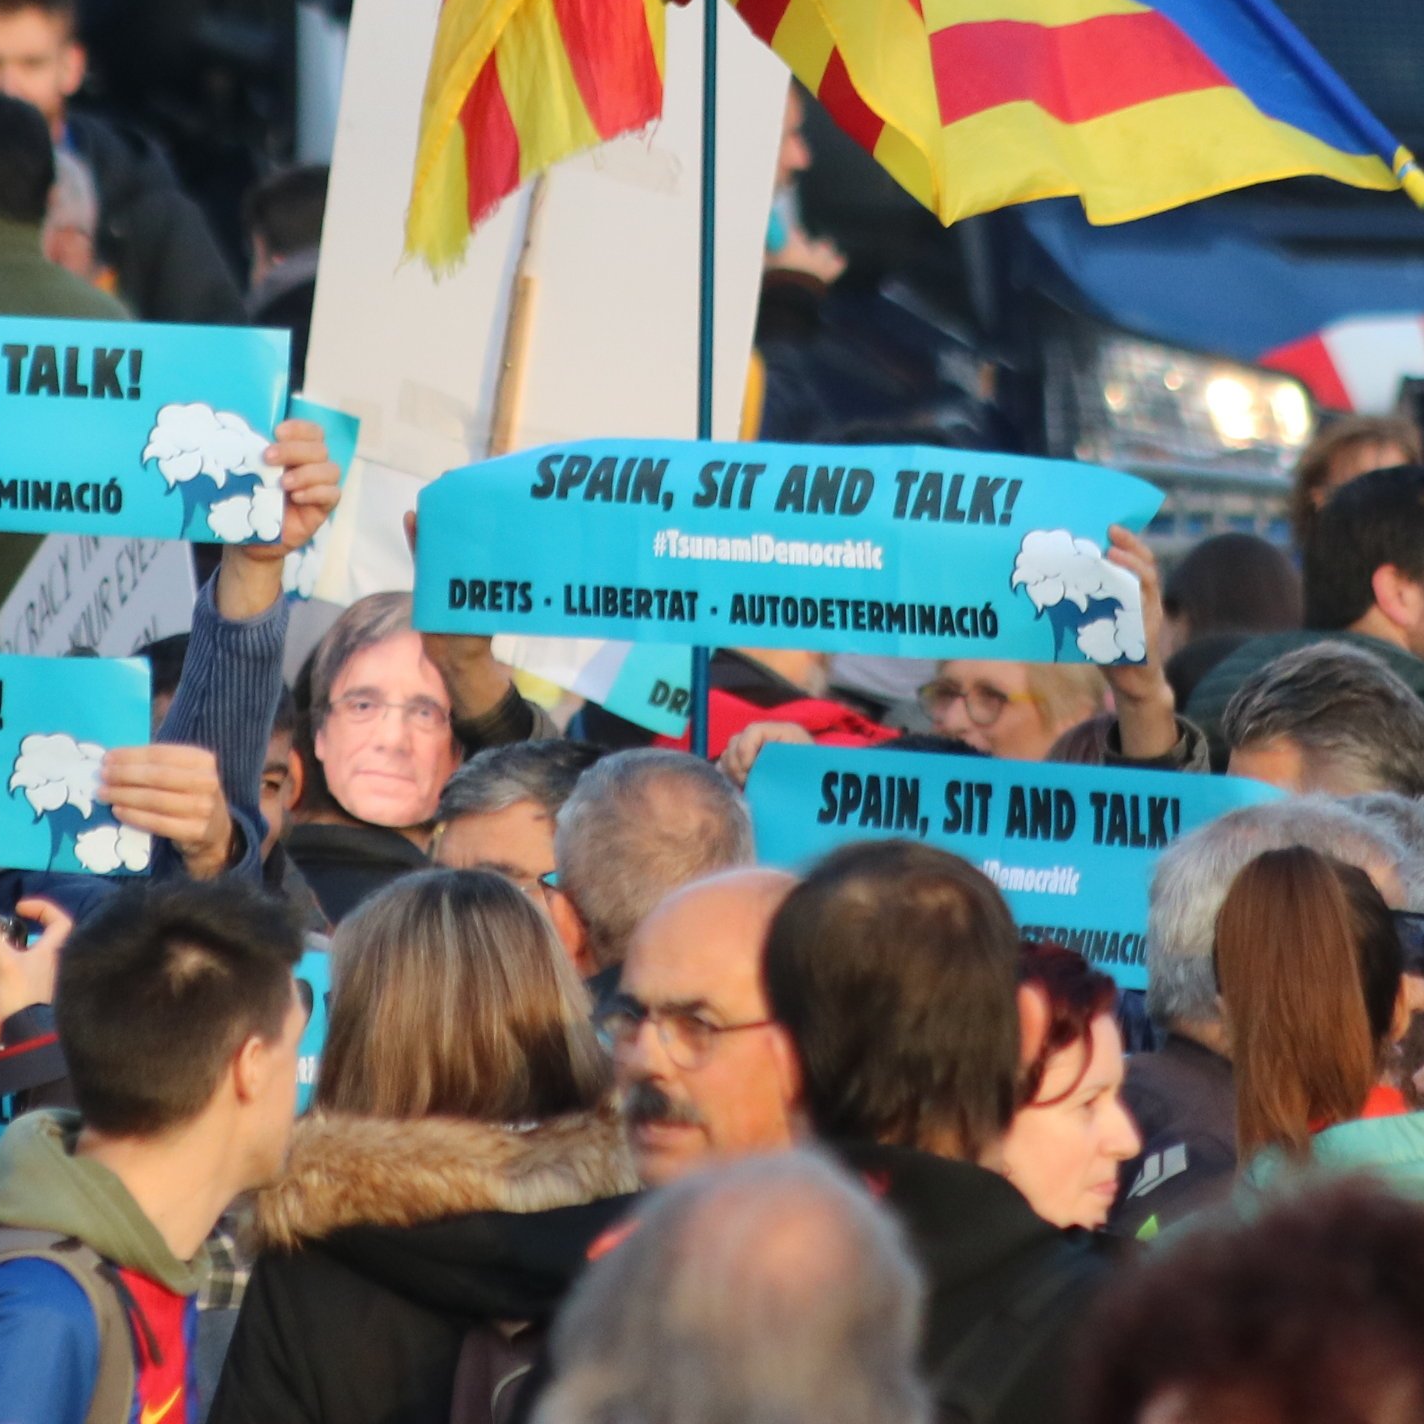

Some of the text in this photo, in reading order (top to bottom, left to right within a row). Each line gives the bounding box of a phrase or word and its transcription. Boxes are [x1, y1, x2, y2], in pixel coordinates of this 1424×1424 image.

[2, 343, 143, 401] TALK!
[530, 454, 1023, 526] SPAIN, SIT AND TALK!
[448, 578, 999, 640] DRETS LLIBERTAT AUTODETERMINACIÓ
[817, 770, 1181, 849] SPAIN, SIT AND TALK!
